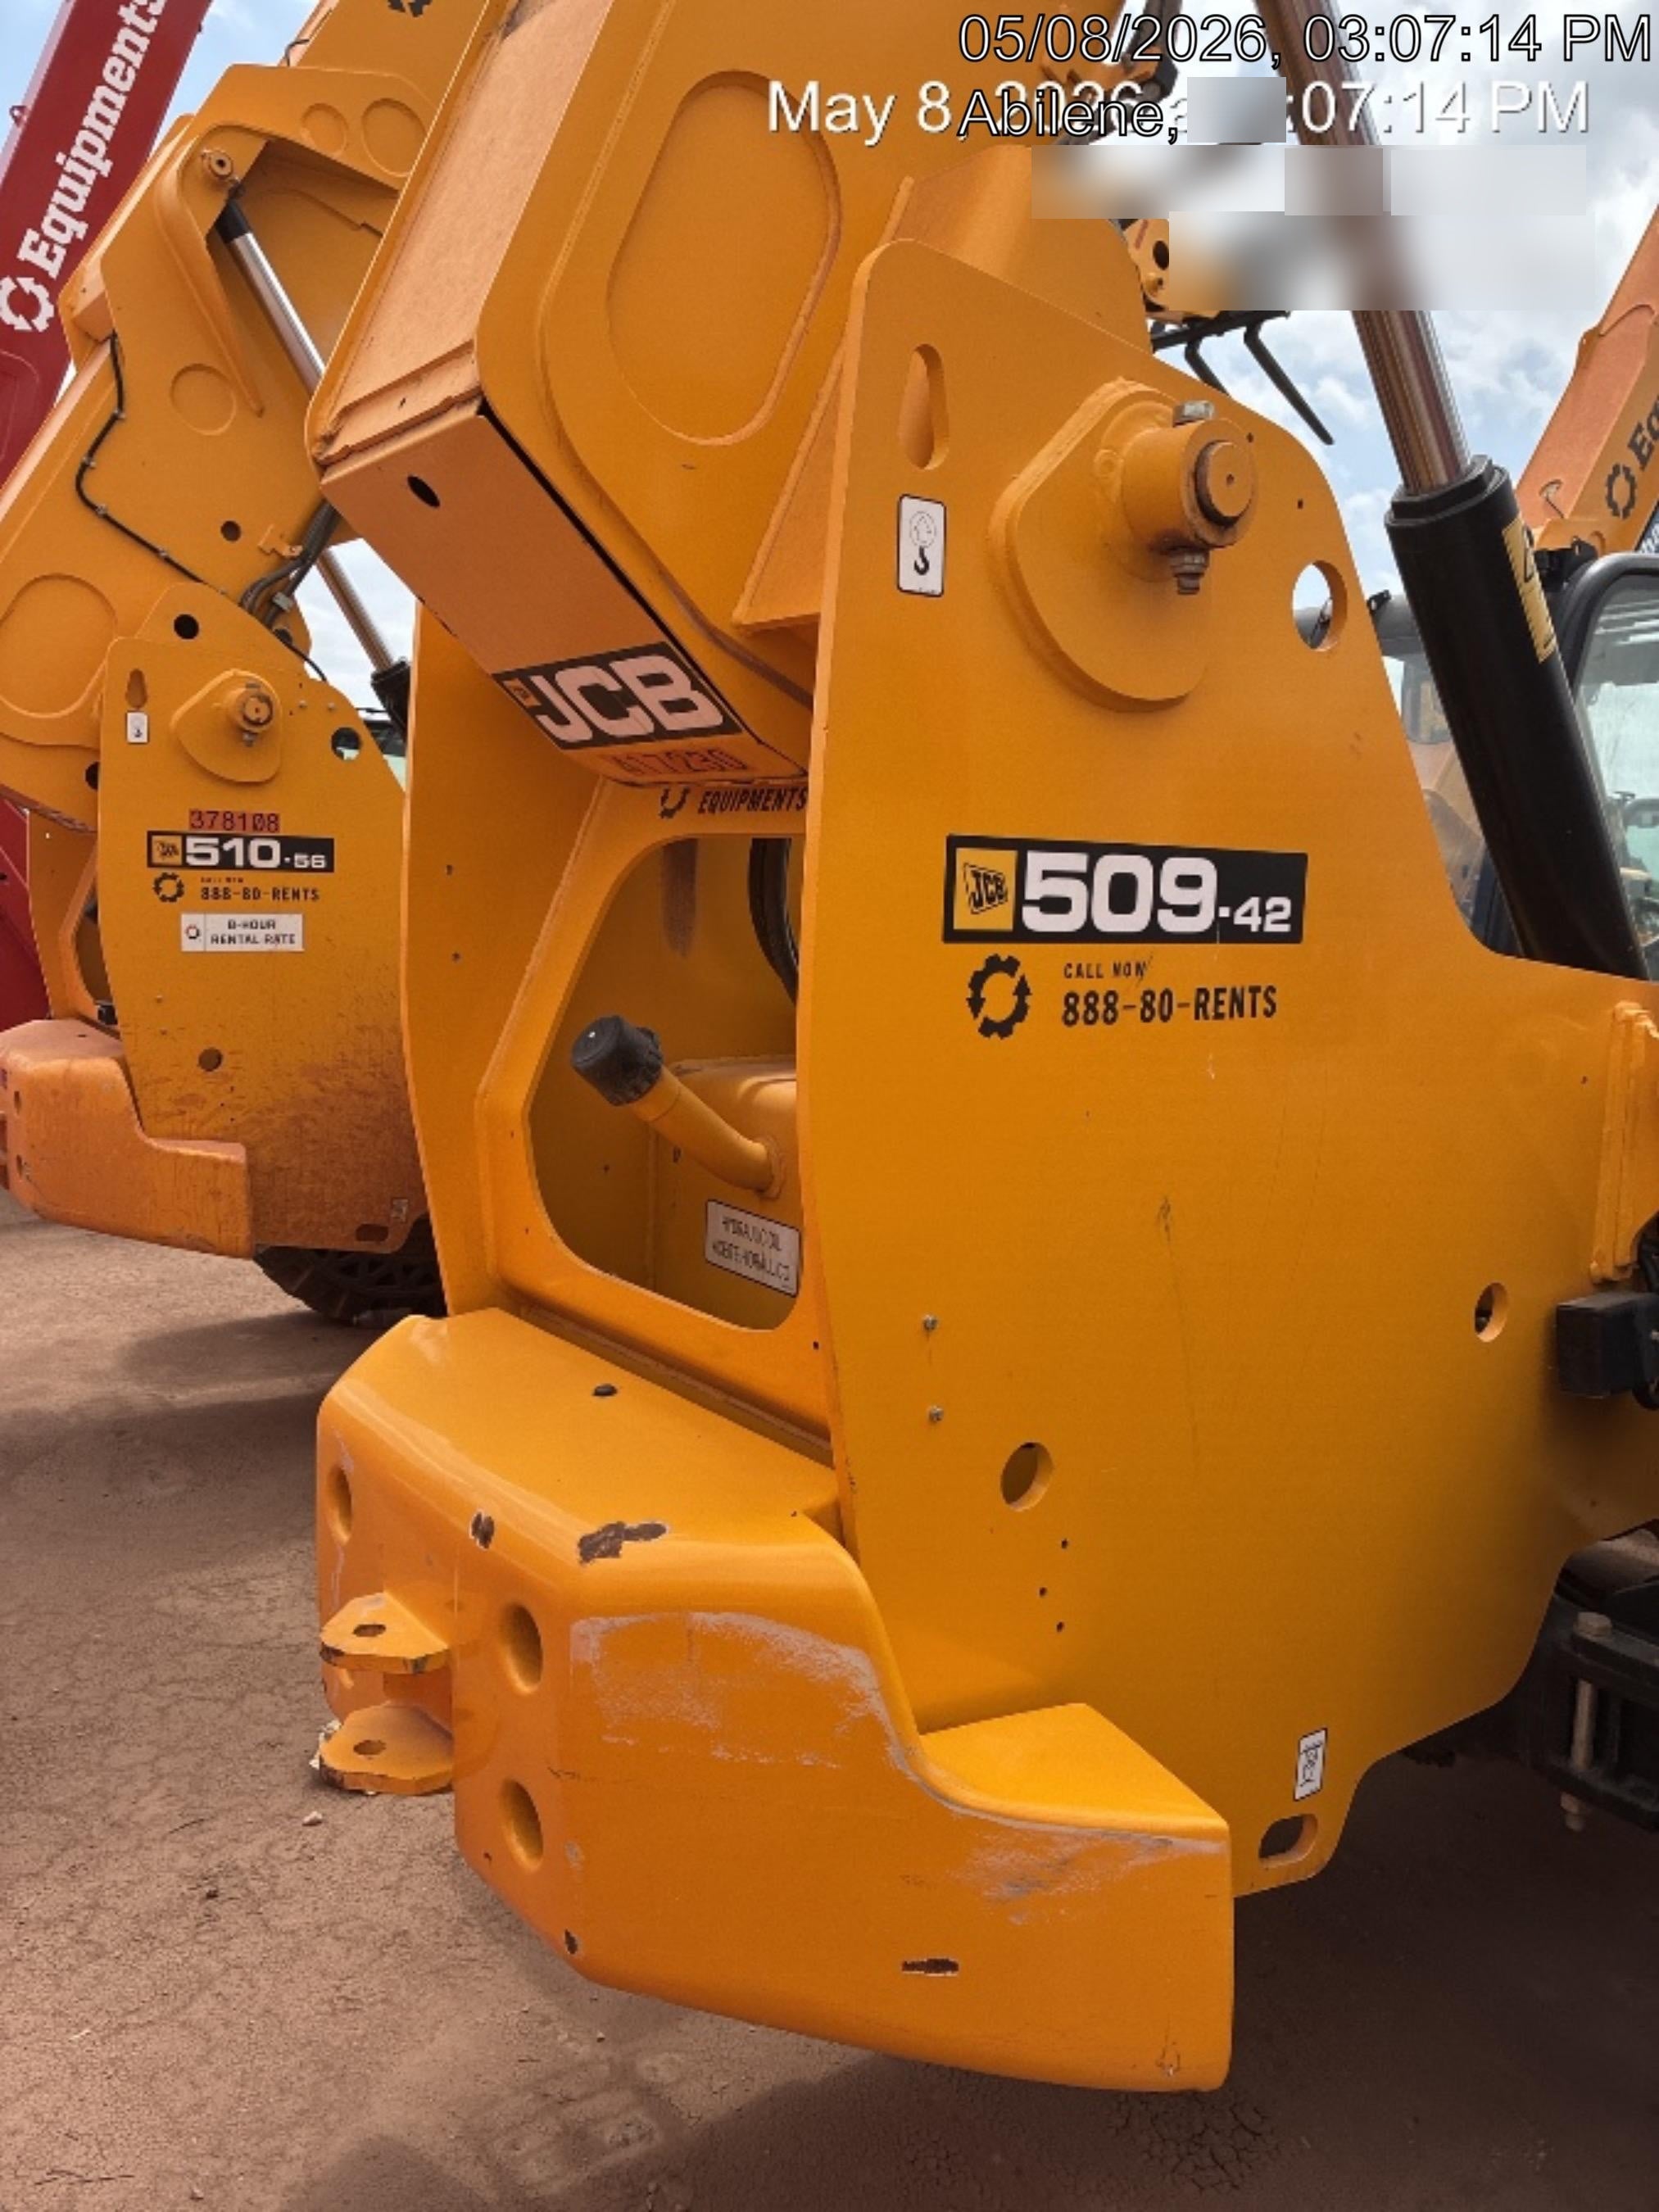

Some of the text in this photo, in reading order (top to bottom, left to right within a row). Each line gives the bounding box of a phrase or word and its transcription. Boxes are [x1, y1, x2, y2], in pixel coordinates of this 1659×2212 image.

[529, 655, 723, 742] JCB
[698, 787, 808, 814] EQUIPMENTS
[189, 809, 279, 834] 378108
[968, 867, 1006, 910] JCB
[1064, 962, 1104, 979] CALL
[1062, 985, 1277, 1027] 888-80-RENTS
